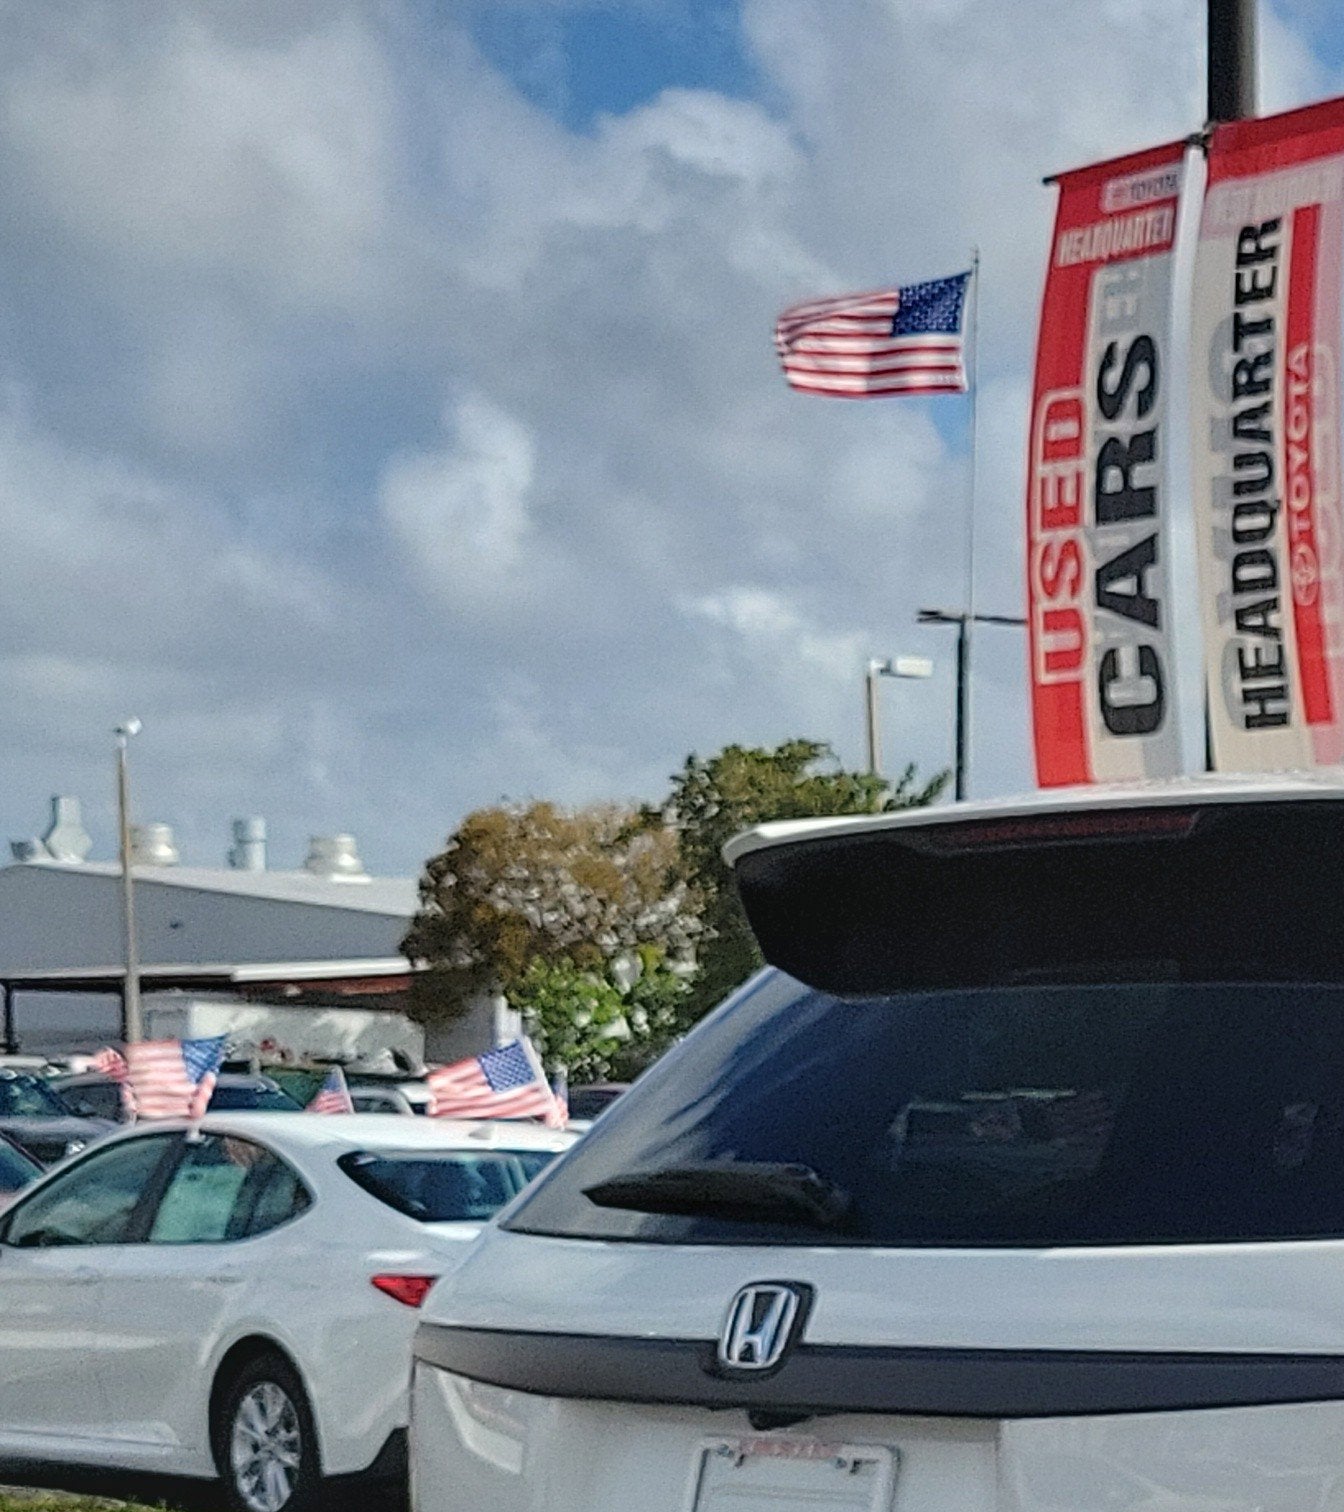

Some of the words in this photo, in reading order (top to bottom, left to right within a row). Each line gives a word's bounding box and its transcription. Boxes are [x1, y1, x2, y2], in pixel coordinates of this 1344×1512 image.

[1038, 390, 1085, 680] USED
[1095, 332, 1165, 735] CARS
[1233, 216, 1290, 730] HEADQUARTER
[1286, 344, 1312, 538] TOYOTA
